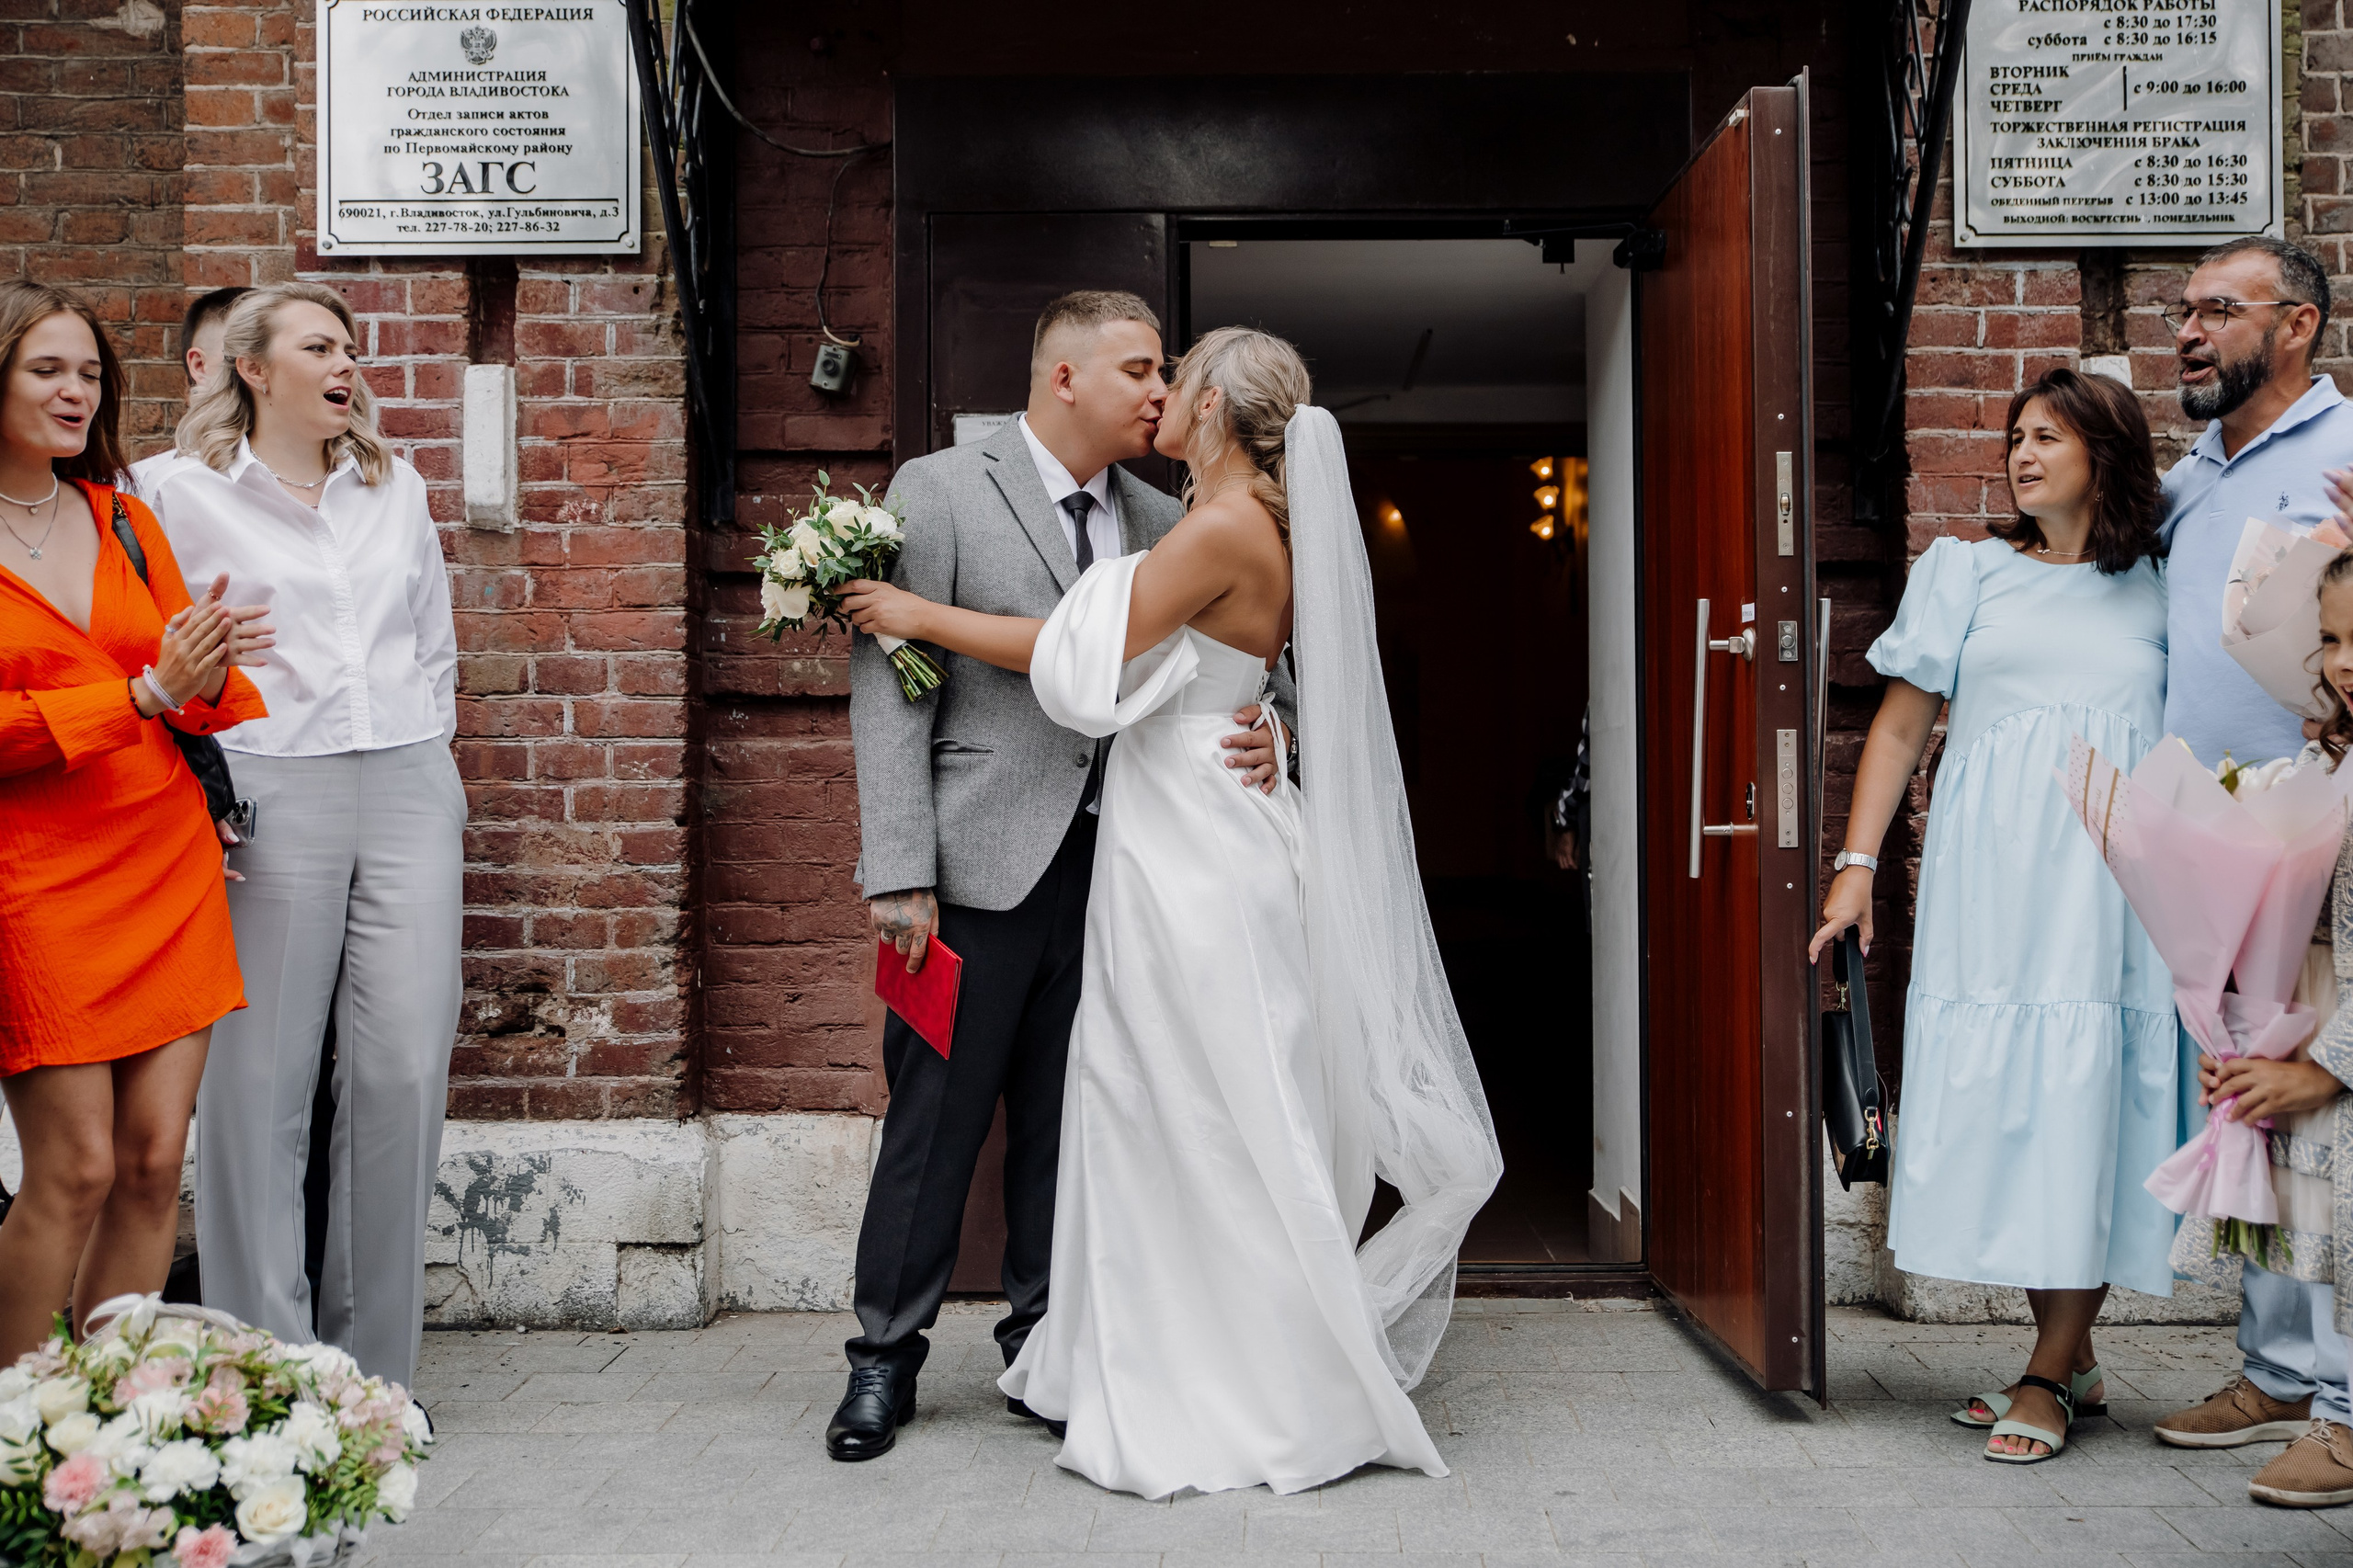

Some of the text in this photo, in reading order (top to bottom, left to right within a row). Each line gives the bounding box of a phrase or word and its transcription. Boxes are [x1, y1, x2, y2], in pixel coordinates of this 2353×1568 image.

[2018, 0, 2216, 13] РАСПОРЯДОК РАБОТЫ
[363, 6, 594, 22] РОССИЙСКАЯ ФЕДЕРАЦИЯ
[2103, 14, 2217, 29] с 8:30 до 17:30
[2027, 30, 2217, 50] суббота с 8:30 до 16:15
[2072, 51, 2164, 62] ПРИЁМ ГРАЖДАН
[408, 70, 547, 84] АДМИНИСТРАЦИЯ
[1990, 65, 2070, 80] ВТОРНИК
[387, 85, 570, 98] ГОРОДА ВЛАДИВОСТОКА
[1989, 83, 2042, 97] СРЕДА
[2133, 80, 2247, 95] с 9:00 до 16:00
[1990, 99, 2063, 113] ЧЕТВЕРГ
[407, 108, 550, 120] Отдел записи актов
[391, 127, 566, 140] гражданского состояния
[1989, 119, 2246, 134] ТОРЖЕСТВЕННАЯ РЕГИСТРАЦИЯ
[383, 142, 574, 156] по Первомайскому району
[2037, 136, 2201, 149] ЗАКЛЮЧЕНИЯ БРАКА
[1990, 153, 2247, 170] ПЯТНИЦА с 8:30 до 16:30
[420, 160, 537, 195] ЗАГС
[1990, 172, 2248, 189] СУББОТА с 8:30 до 15:30
[1990, 191, 2248, 208] ОБЕДЕННЫЙ ПЕРЕРЫВ с 13:00 до 13:45
[338, 208, 386, 220] 690021,
[599, 206, 620, 218] д.3
[2153, 213, 2235, 224] ПОНЕДЕЛЬНИК
[396, 221, 561, 234] тел. 227-78-20; 227-86-32
